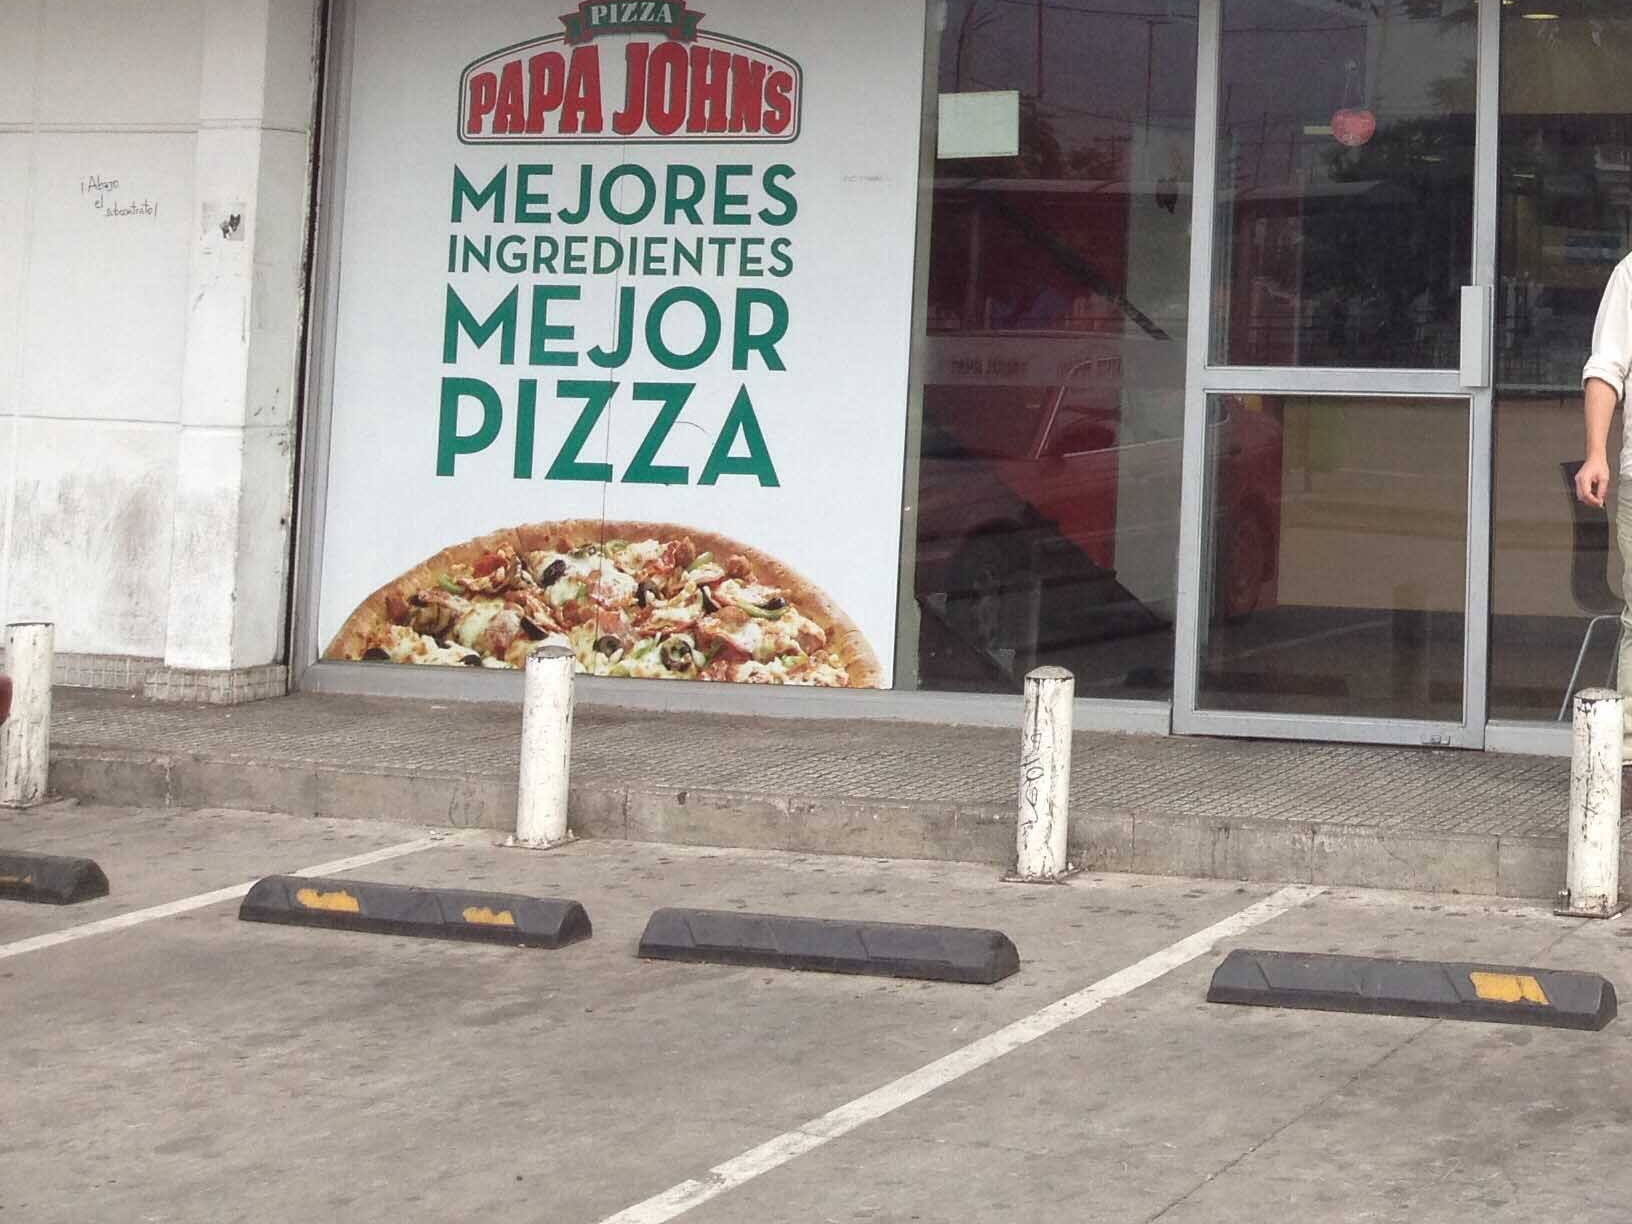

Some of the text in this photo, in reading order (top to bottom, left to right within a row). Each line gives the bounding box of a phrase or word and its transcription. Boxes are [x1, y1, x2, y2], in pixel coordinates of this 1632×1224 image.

[466, 45, 604, 136] PAPA
[450, 162, 799, 226] MEJORES
[447, 234, 795, 278] INGREDIENTES
[441, 282, 790, 372] MEJOR
[435, 377, 781, 488] PIZZA
